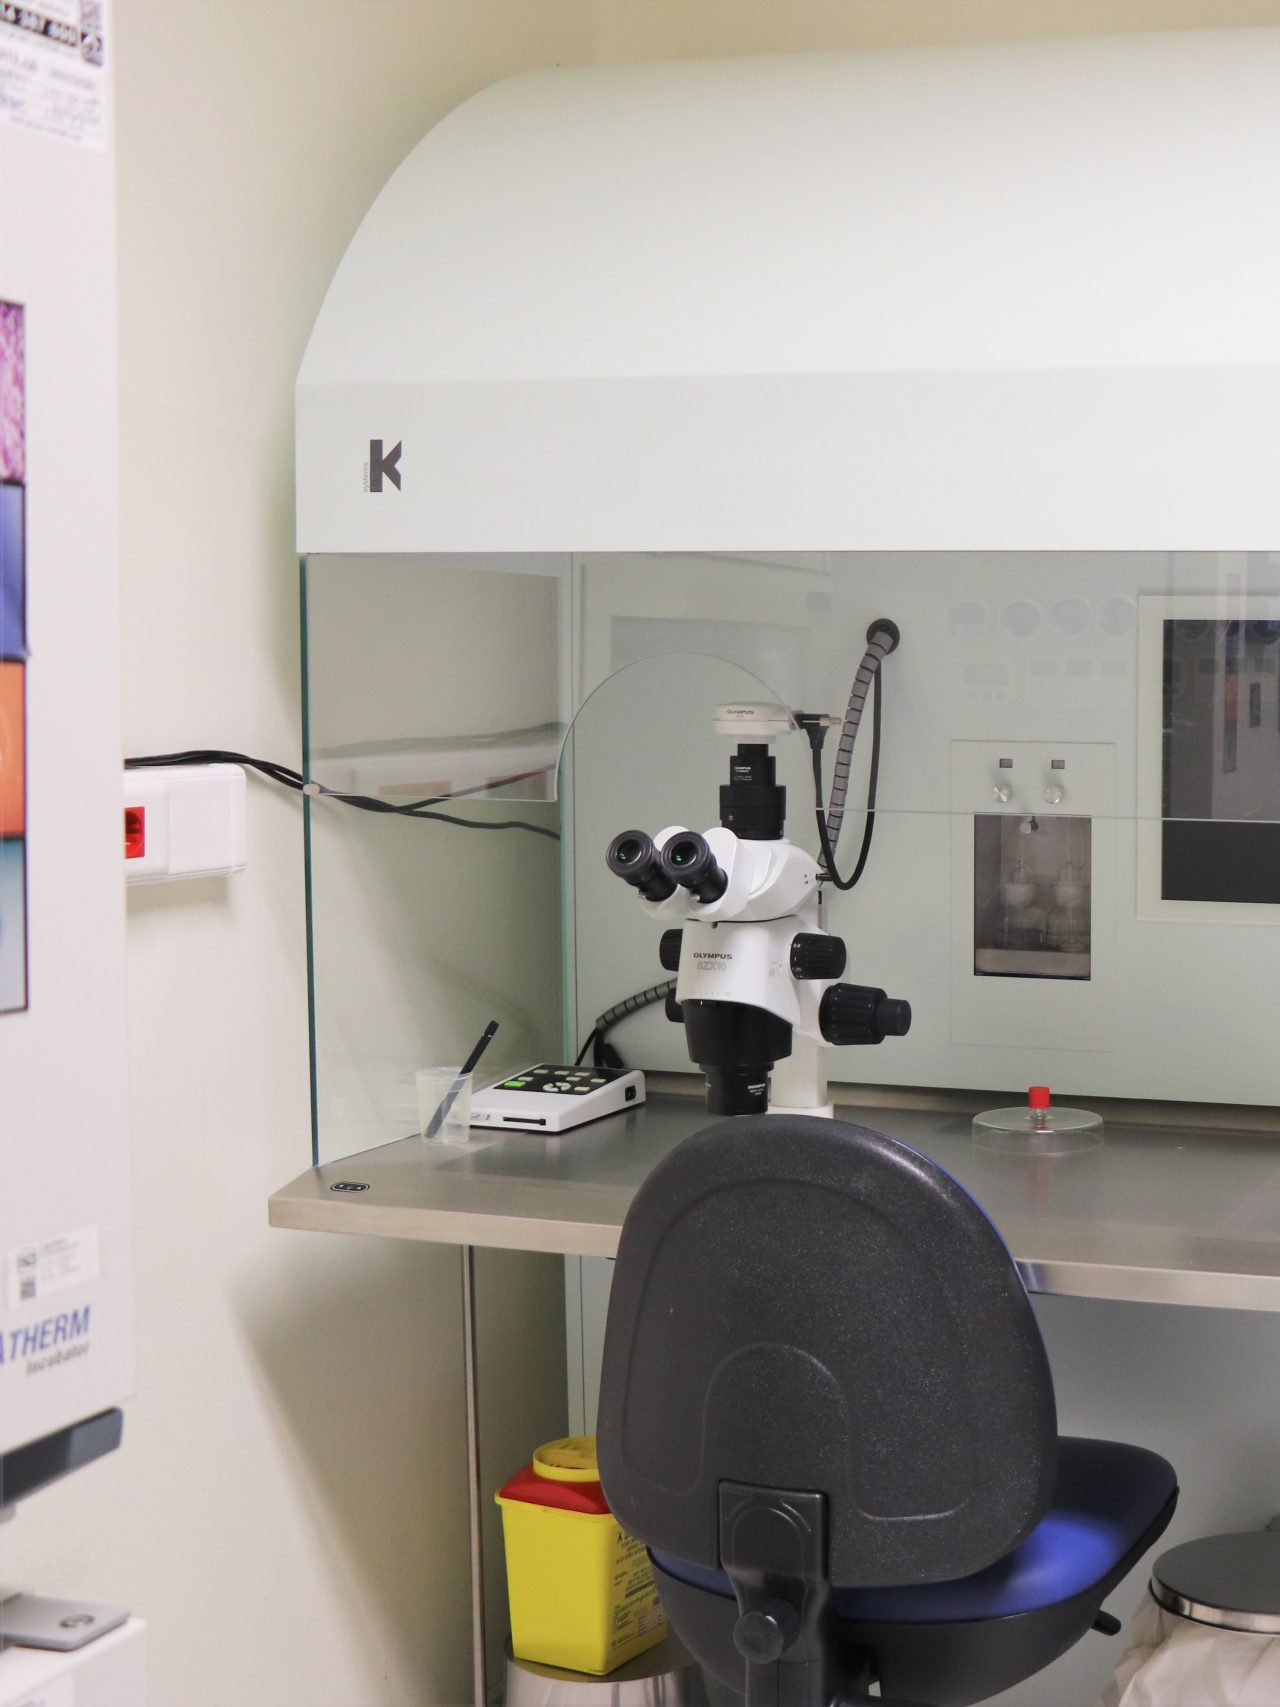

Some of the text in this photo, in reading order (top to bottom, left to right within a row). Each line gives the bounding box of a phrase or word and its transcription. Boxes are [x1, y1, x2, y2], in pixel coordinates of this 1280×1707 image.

[369, 439, 402, 493] K
[693, 952, 733, 960] OLYMPUS
[696, 961, 728, 972] SZX10
